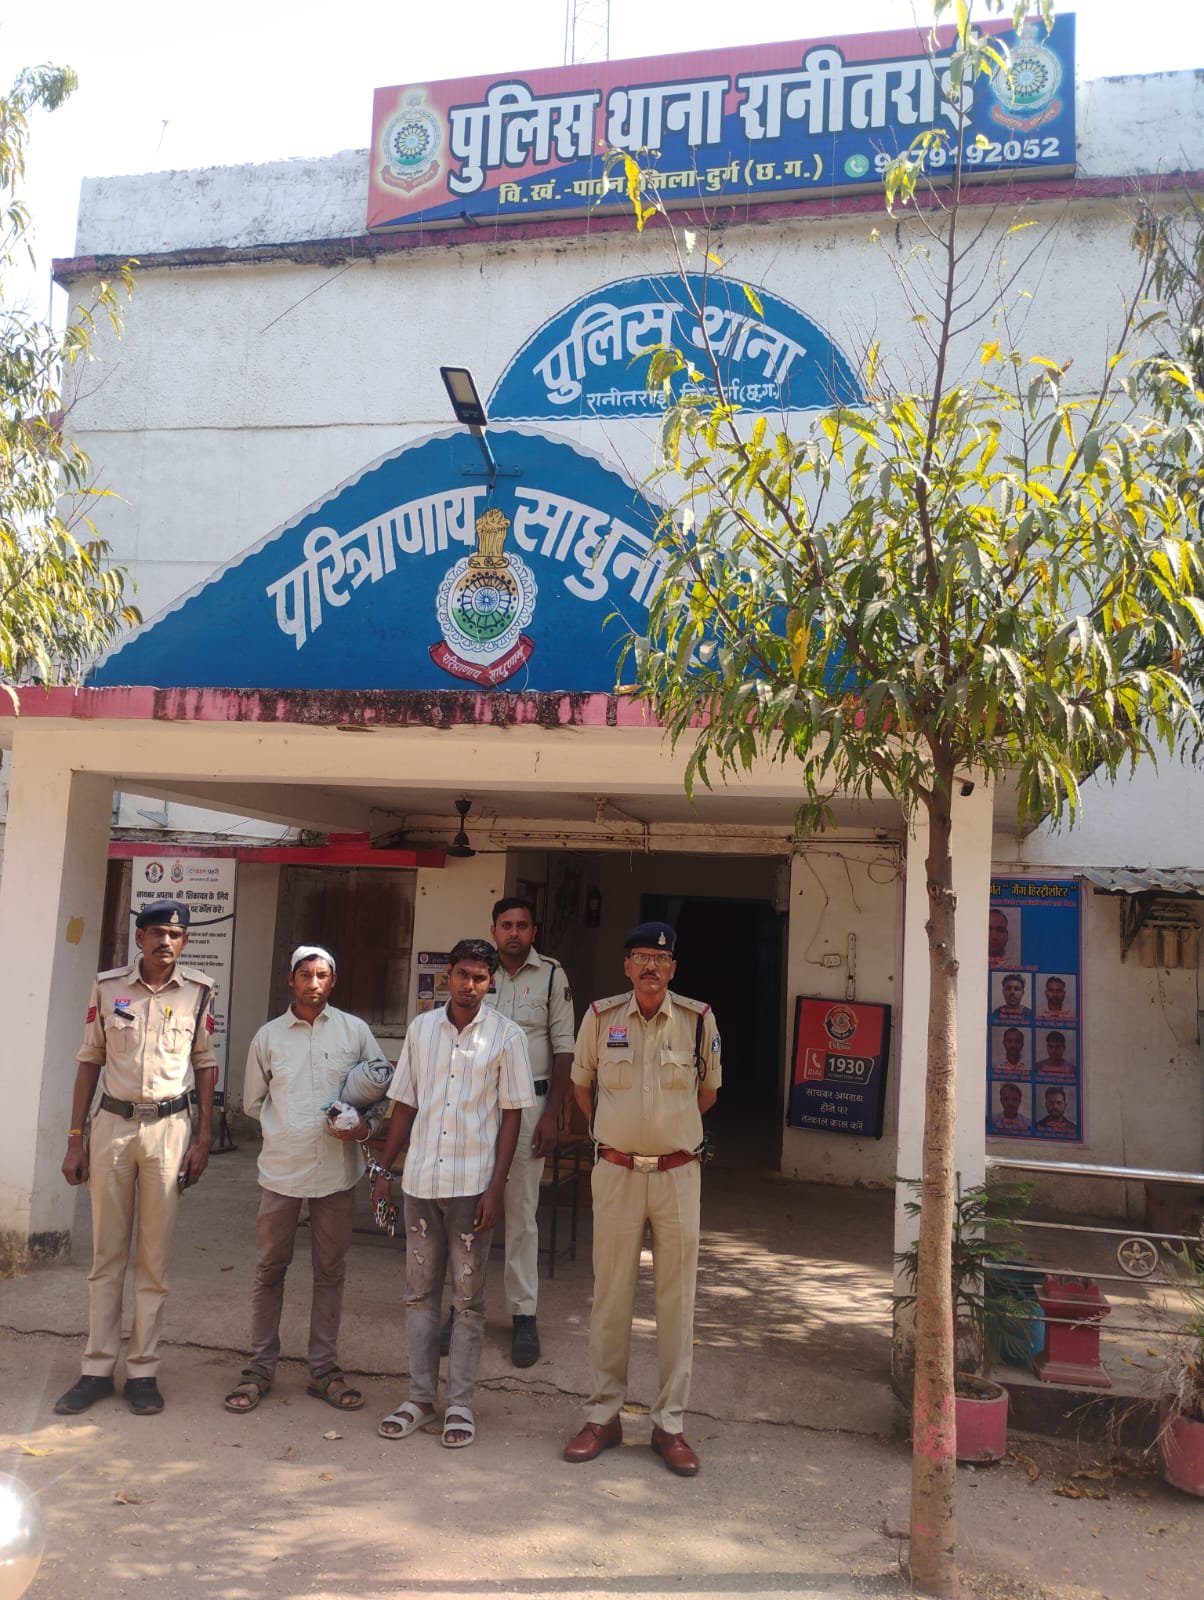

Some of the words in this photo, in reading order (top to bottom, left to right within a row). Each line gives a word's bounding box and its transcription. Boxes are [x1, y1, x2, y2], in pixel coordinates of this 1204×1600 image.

[450, 84, 600, 193] पुलिस
[608, 79, 728, 154] थाना
[740, 31, 975, 140] रानीतराई
[532, 302, 683, 405] पुलिस
[692, 305, 807, 384] थाना
[266, 485, 487, 651] परित्राणाय
[828, 1057, 865, 1075] 1930
